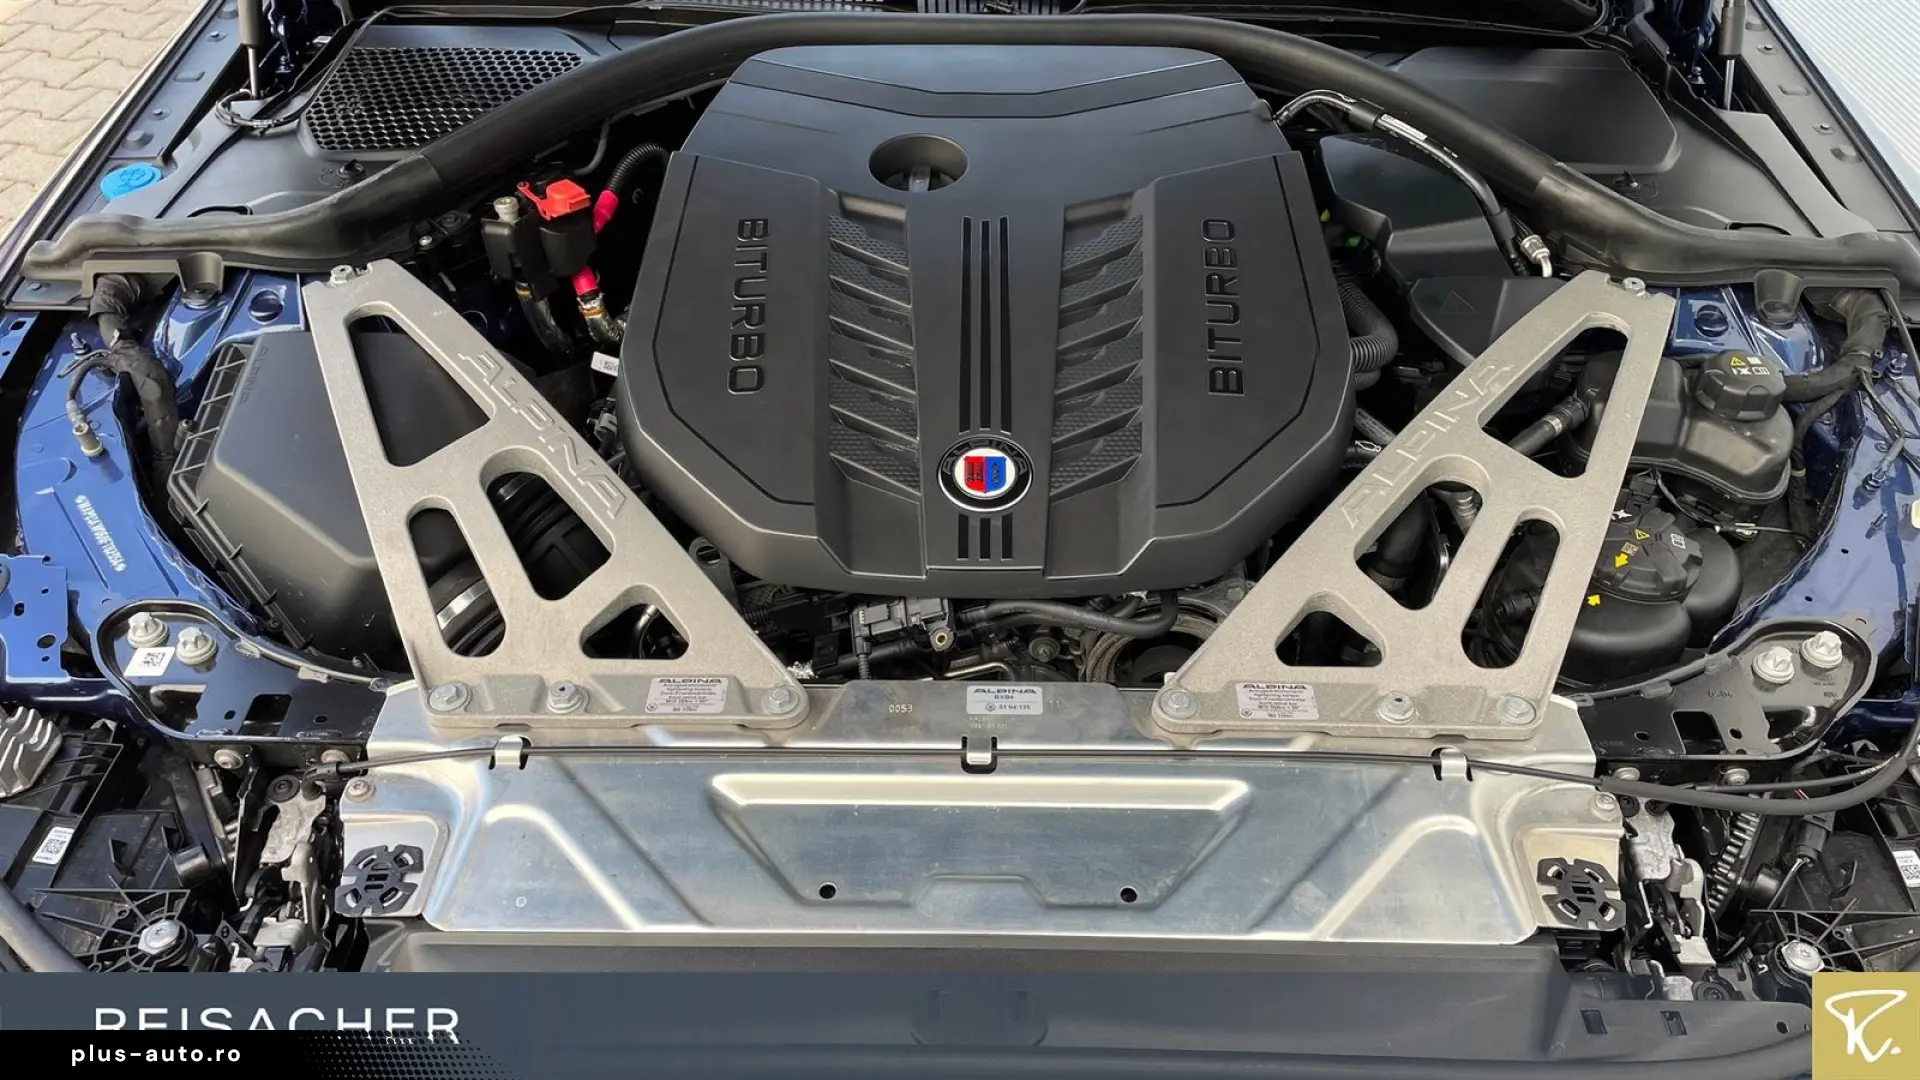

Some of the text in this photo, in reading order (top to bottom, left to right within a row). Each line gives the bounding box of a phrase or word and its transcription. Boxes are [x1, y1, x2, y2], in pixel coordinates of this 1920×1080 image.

[727, 218, 769, 395] BITURBO
[1201, 217, 1245, 396] BITURBO
[457, 350, 627, 519] ALPINA
[942, 438, 1028, 475] ALPINA
[1340, 359, 1515, 528] ALPINA
